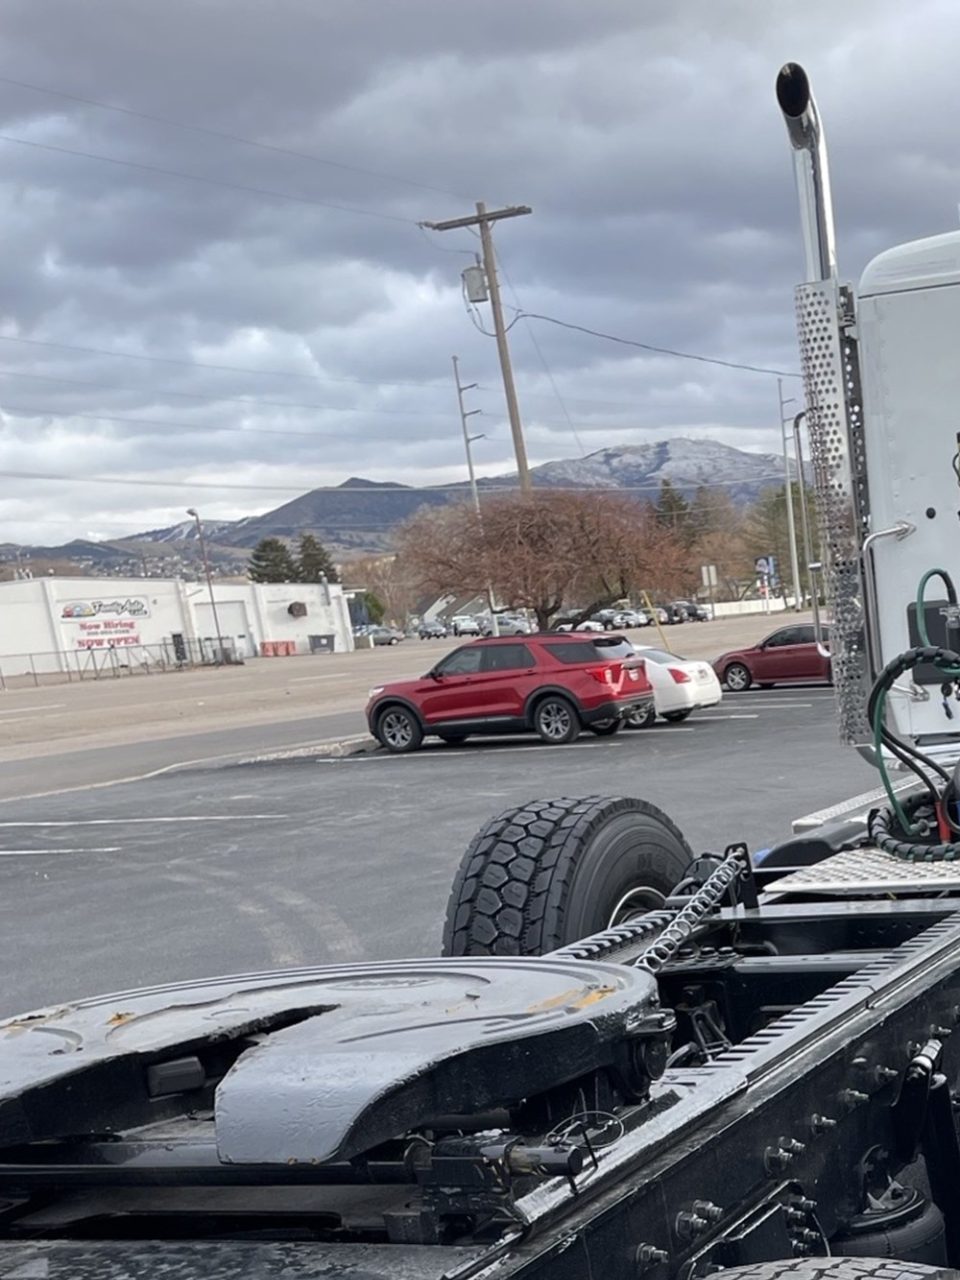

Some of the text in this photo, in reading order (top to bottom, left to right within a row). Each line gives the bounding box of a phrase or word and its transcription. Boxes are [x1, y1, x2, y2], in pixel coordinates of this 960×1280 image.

[79, 620, 135, 630] Now Hiring
[77, 635, 139, 648] NOW OPEN
